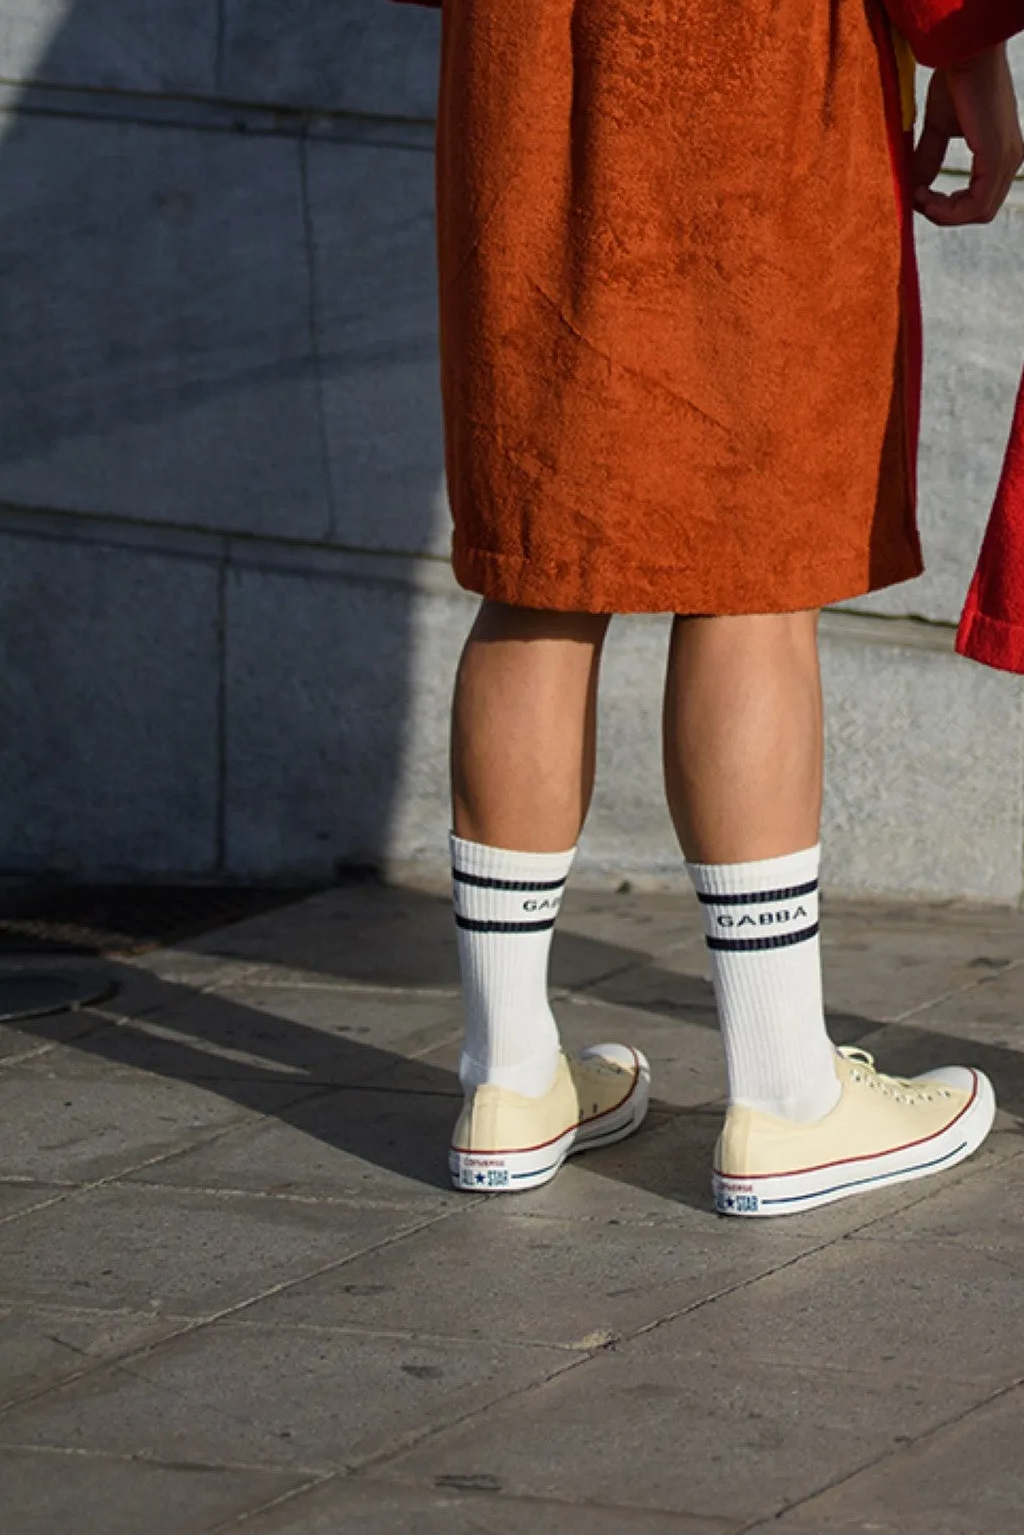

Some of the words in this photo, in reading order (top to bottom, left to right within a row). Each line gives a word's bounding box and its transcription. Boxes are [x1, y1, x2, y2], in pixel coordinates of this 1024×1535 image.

[716, 905, 808, 928] GABBA
[487, 1170, 509, 1186] STAR
[736, 1195, 759, 1212] STAR
